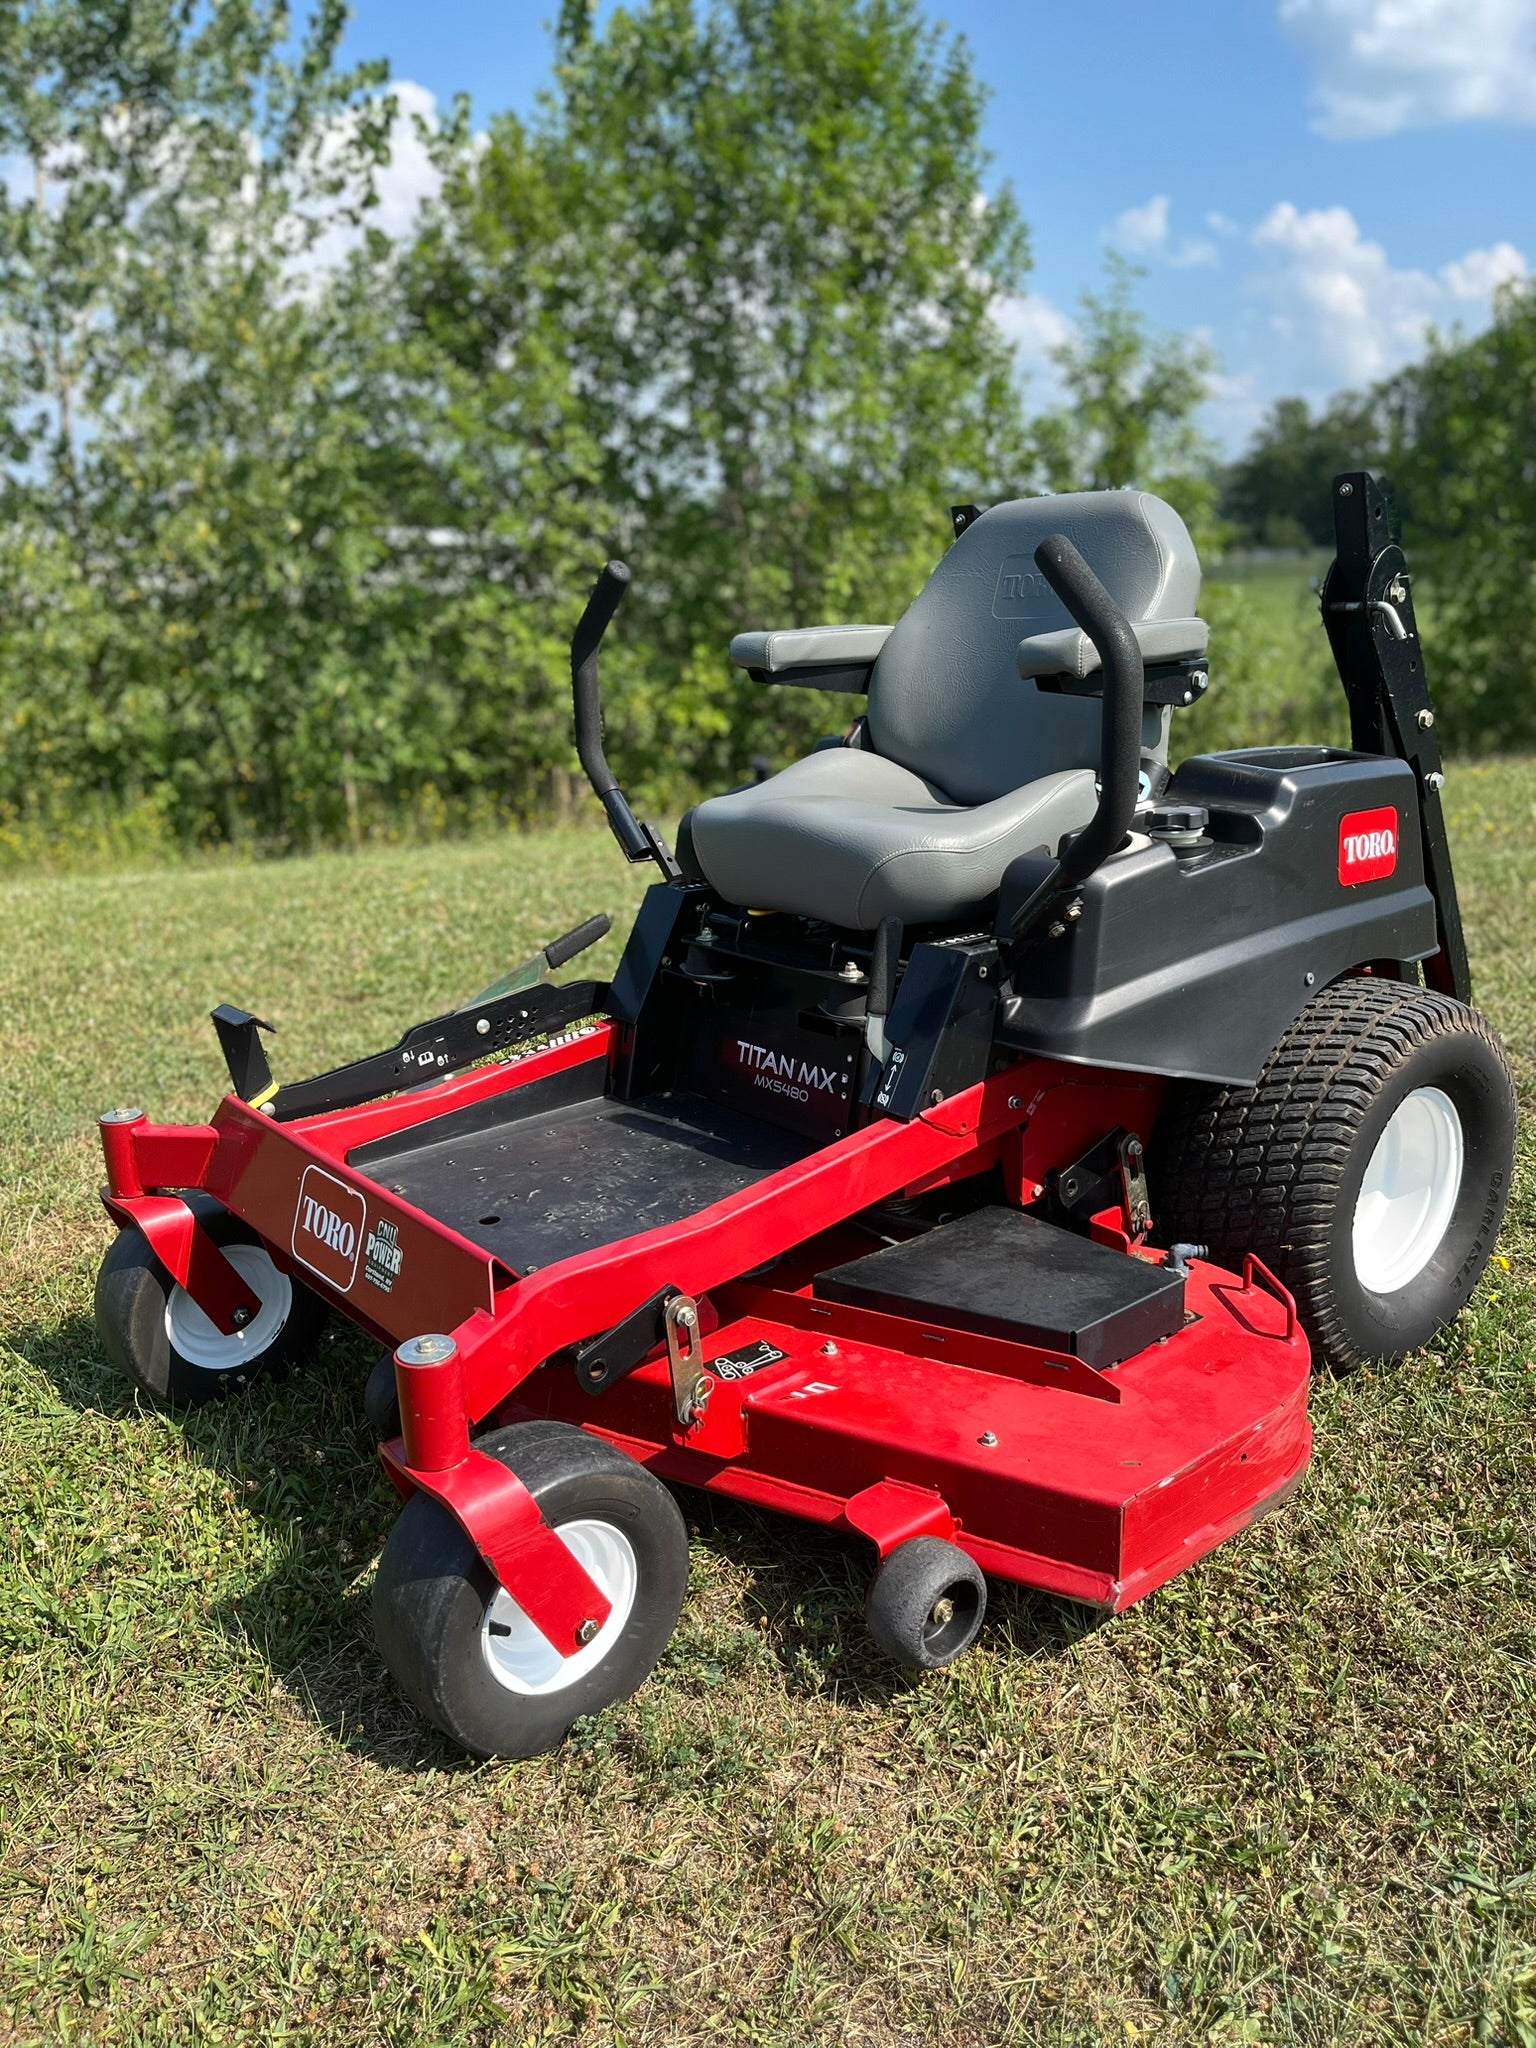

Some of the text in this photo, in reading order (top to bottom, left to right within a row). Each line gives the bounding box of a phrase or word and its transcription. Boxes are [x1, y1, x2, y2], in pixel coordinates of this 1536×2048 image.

[1002, 573, 1053, 597] TOR
[737, 1040, 837, 1094] TITAN MX
[754, 1074, 809, 1102] MX5480
[1450, 1168, 1504, 1295] CARLISLE
[365, 1232, 401, 1274] POWER
